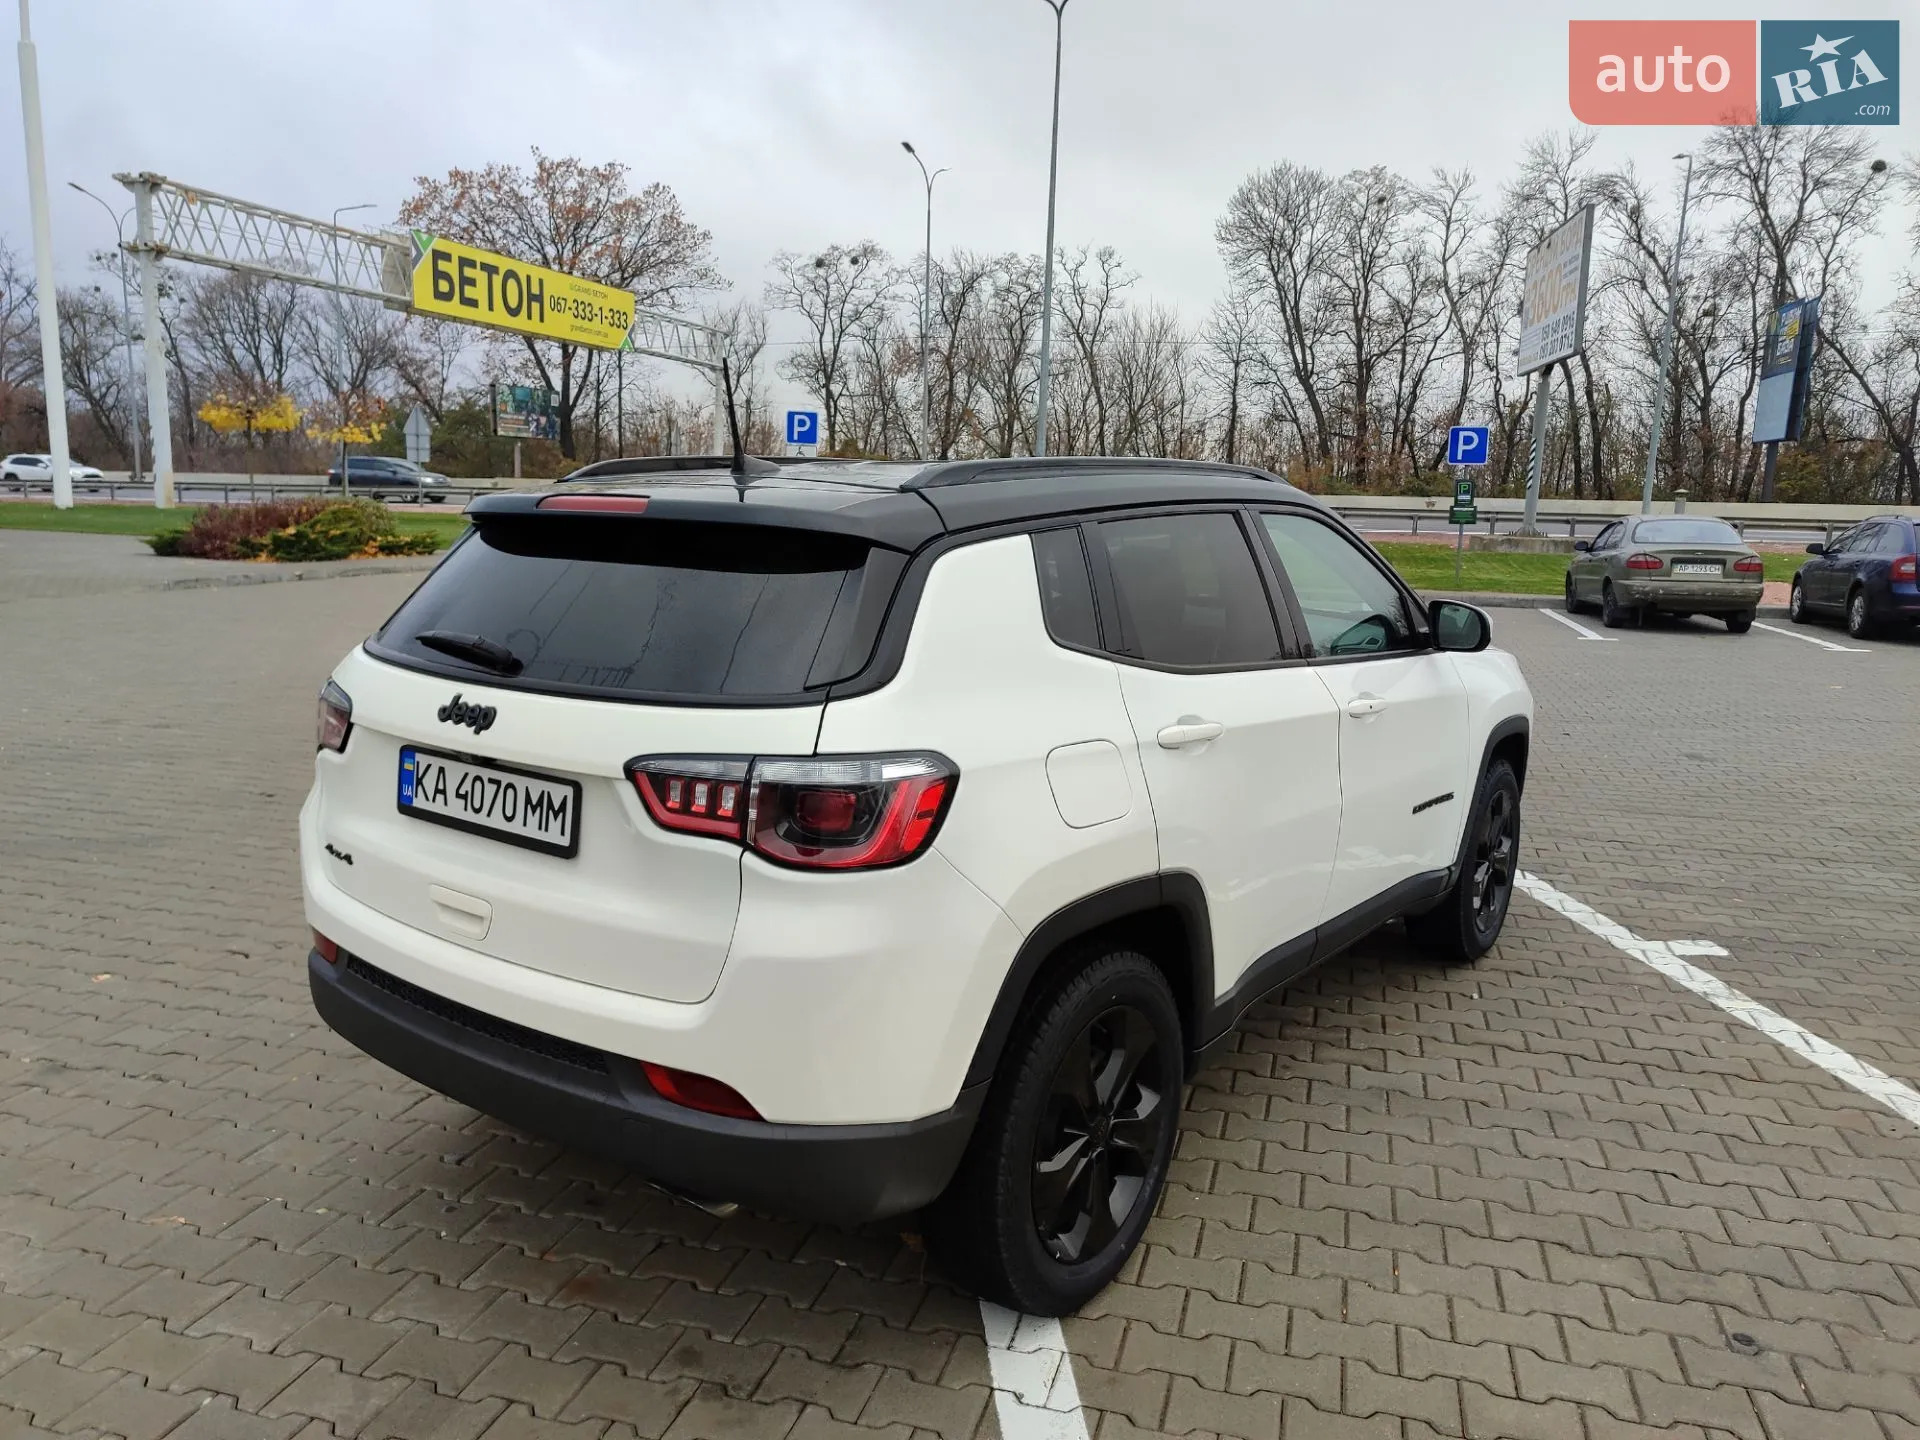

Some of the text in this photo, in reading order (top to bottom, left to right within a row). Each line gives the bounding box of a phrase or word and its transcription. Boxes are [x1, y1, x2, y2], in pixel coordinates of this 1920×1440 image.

[431, 248, 545, 323] БЕТОН
[549, 294, 628, 331] 067-333-1-333
[793, 414, 811, 441] P
[1457, 430, 1479, 460] P
[437, 693, 498, 735] Jeep
[402, 783, 413, 796] UA
[414, 760, 568, 837] KA 4070 MM
